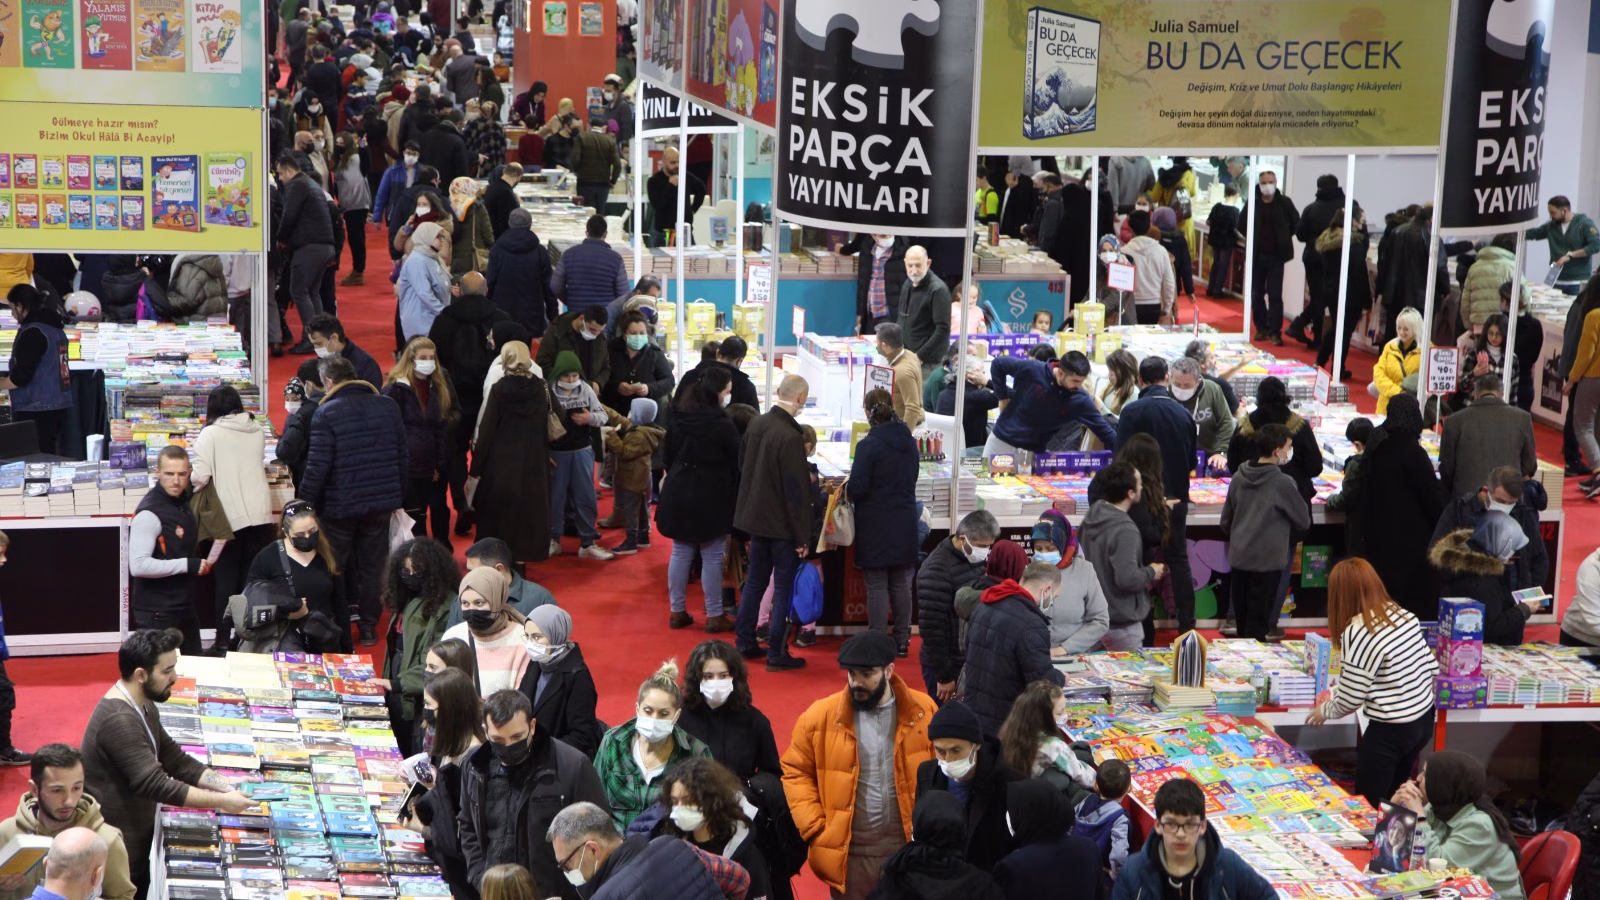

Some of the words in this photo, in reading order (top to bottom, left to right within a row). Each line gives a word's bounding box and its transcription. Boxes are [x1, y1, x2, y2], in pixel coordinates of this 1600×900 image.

[1040, 16, 1055, 26] Julia
[1055, 19, 1076, 29] Samuel
[1149, 20, 1184, 34] Julia
[1188, 20, 1240, 34] Samuel
[1039, 26, 1057, 41] BU
[1060, 30, 1077, 44] DA
[1046, 42, 1097, 60] GEÇECEK
[1146, 41, 1188, 70] BU
[1199, 41, 1246, 70] DA
[1256, 40, 1404, 76] GEÇECEK
[1187, 82, 1227, 94] Değişim,
[1229, 82, 1247, 92] Kriz
[1249, 84, 1260, 92] ve
[1262, 82, 1286, 92] Umut
[1288, 82, 1308, 92] Dolu
[1310, 81, 1354, 93] Başlangıç
[1159, 109, 1191, 119] Değişim
[1193, 109, 1206, 118] her
[1208, 110, 1229, 119] şeyin
[1230, 109, 1252, 119] doğal
[1253, 109, 1294, 119] düzeniyse,
[1296, 108, 1320, 117] neden
[1321, 107, 1376, 118] hayatımızdaki
[51, 116, 94, 129] Gülmeye
[96, 118, 124, 128] hazır
[127, 119, 159, 129] mısın?
[1177, 120, 1205, 129] devasa
[1206, 120, 1234, 129] dönüm
[1235, 119, 1281, 130] noktalarıyla
[1282, 119, 1320, 128] mücadele
[1321, 119, 1359, 129] ediyoruz?
[38, 130, 69, 141] Bizim
[72, 130, 96, 141] Okul
[98, 131, 120, 142] Hâlâ
[123, 132, 133, 142] Bi
[136, 132, 176, 145] Acayip!
[788, 124, 933, 181] PARÇA
[787, 172, 930, 214] YAYINLARI
[1048, 281, 1064, 294] 413
